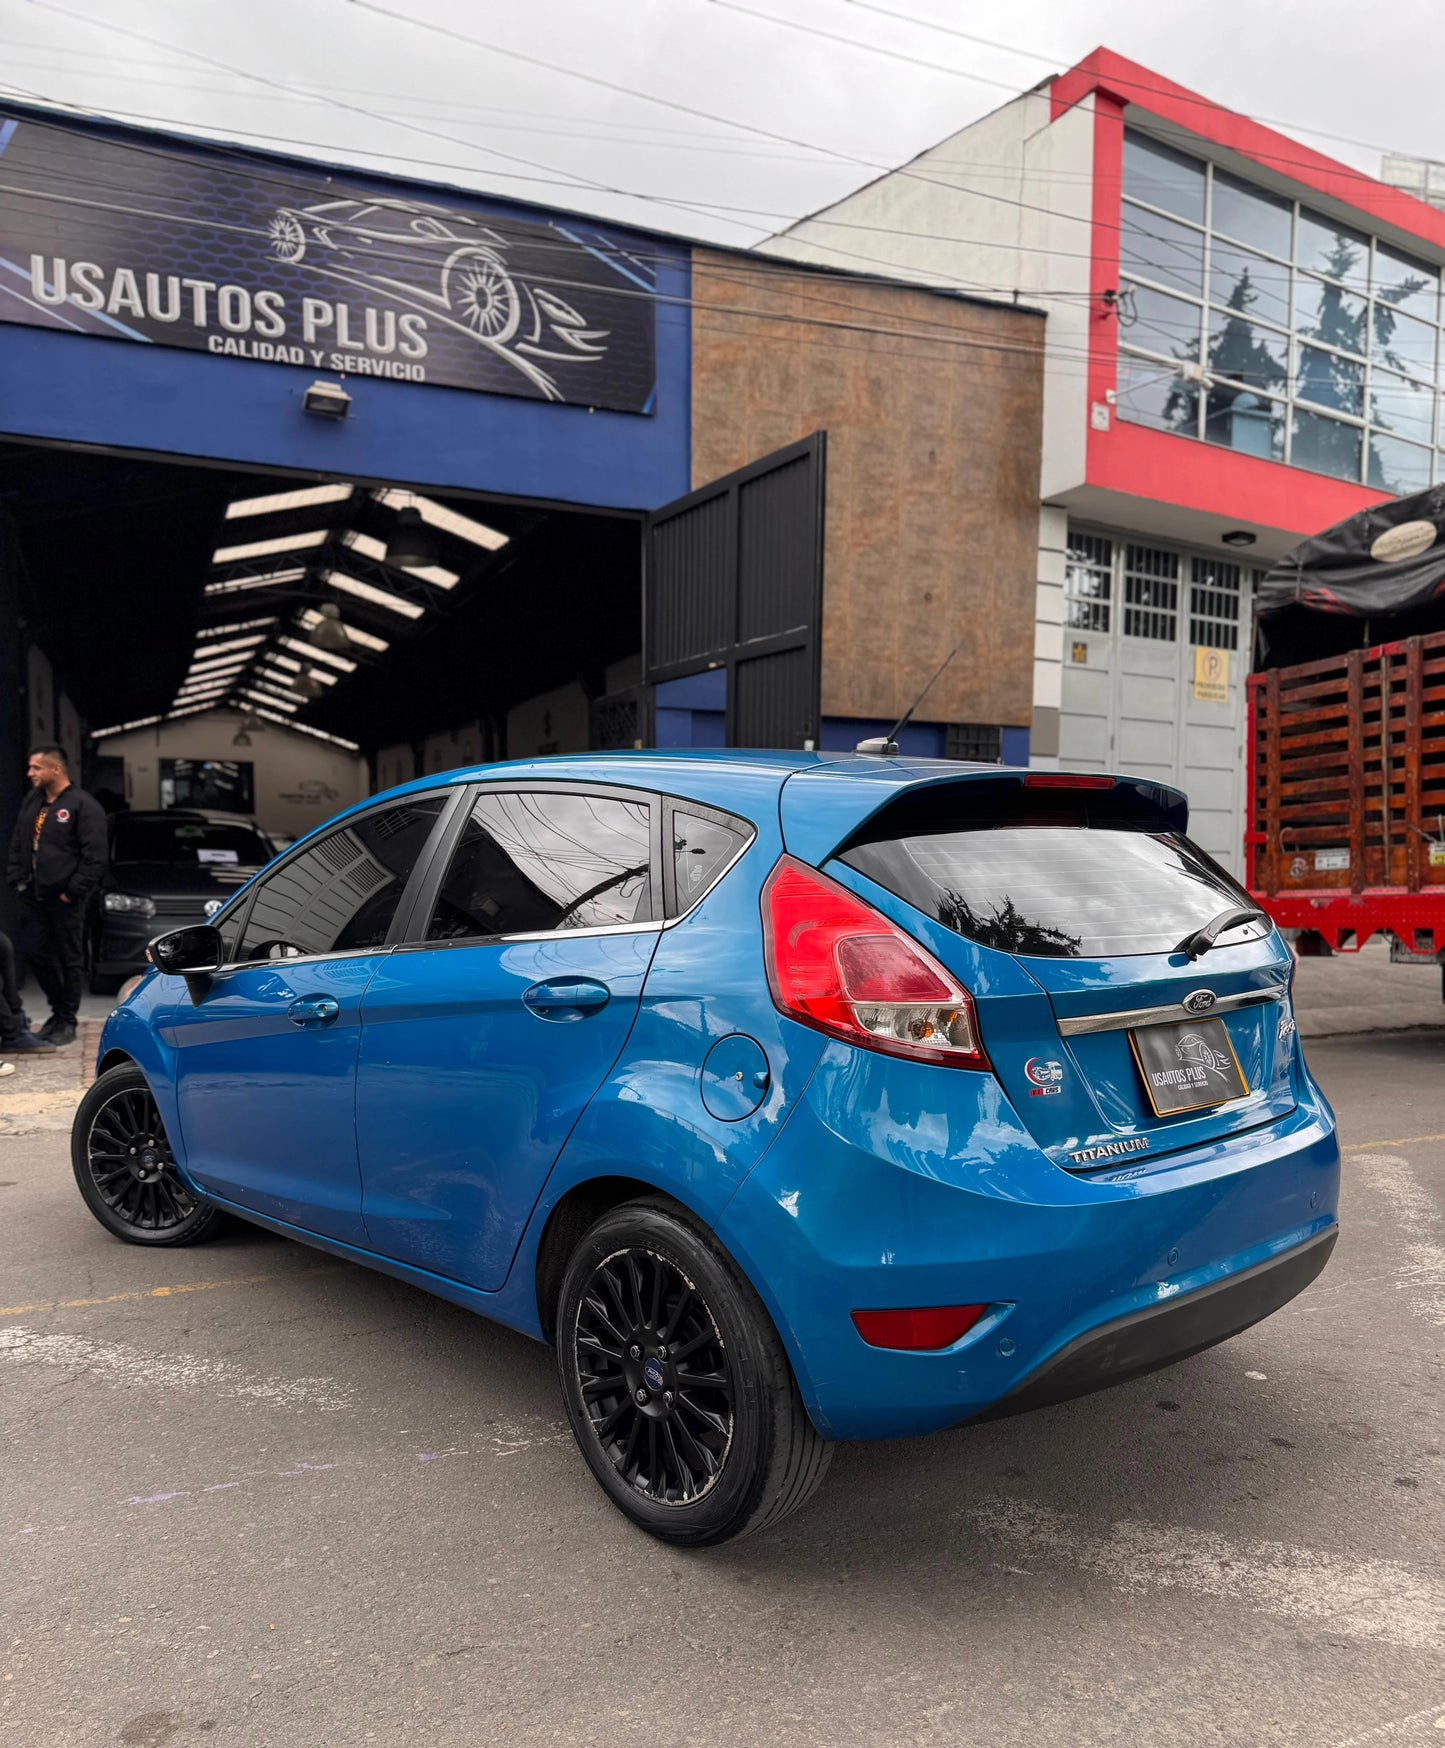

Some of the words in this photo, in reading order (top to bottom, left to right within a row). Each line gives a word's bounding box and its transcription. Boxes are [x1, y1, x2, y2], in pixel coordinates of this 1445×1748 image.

[31, 254, 286, 338] USAUTOS
[302, 297, 428, 359] PLUS
[208, 335, 304, 365] CALIDAD
[309, 350, 325, 368] Y
[330, 352, 425, 382] SERVICIO
[1193, 994, 1213, 1009] Ford
[1152, 1069, 1187, 1087] USAUTOS
[1185, 1066, 1206, 1081] PLUS
[1069, 1137, 1149, 1163] TITANIUM
